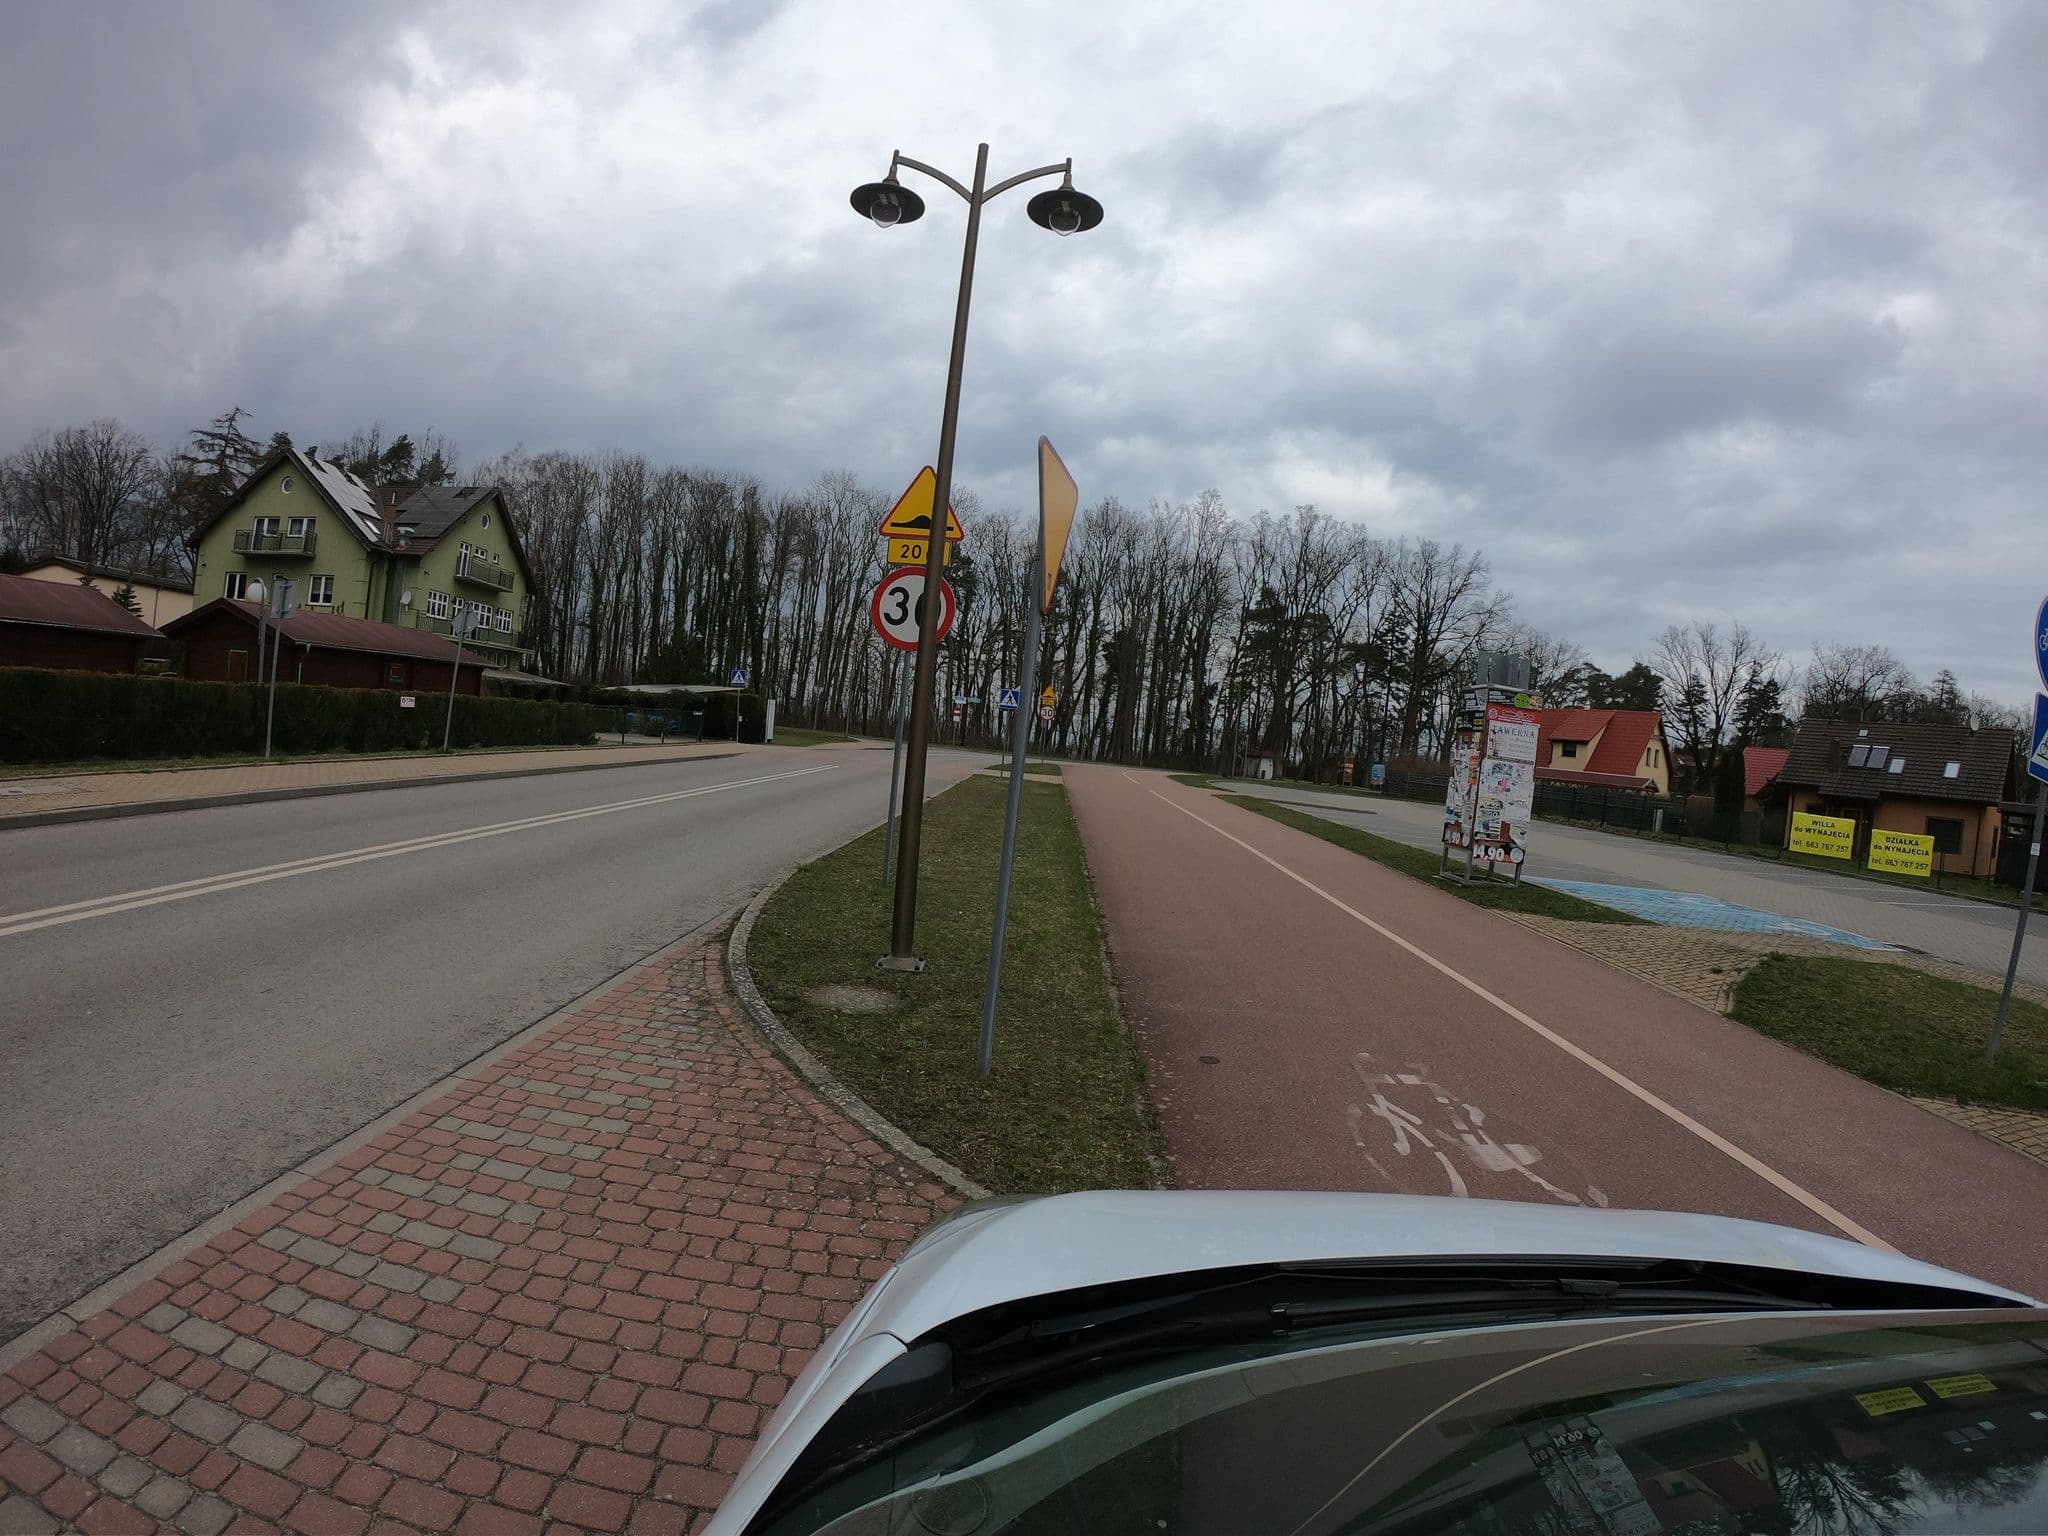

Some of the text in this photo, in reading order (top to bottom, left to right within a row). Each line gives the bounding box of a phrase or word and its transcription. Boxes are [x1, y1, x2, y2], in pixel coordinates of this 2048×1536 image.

[900, 544, 922, 559] 20
[1042, 708, 1052, 717] 30
[1492, 725, 1535, 738] TAWERNA
[1812, 820, 1835, 828] WILLA
[1805, 827, 1850, 839] WYNAJĘCIA
[1806, 841, 1819, 849] 663
[1836, 845, 1849, 853] 257
[1885, 837, 1919, 846] DZIAŁKA
[1884, 846, 1929, 856] WYNAJĘCIA
[1885, 858, 1898, 866] 663
[1900, 861, 1913, 869] 767
[1915, 862, 1929, 870] 257
